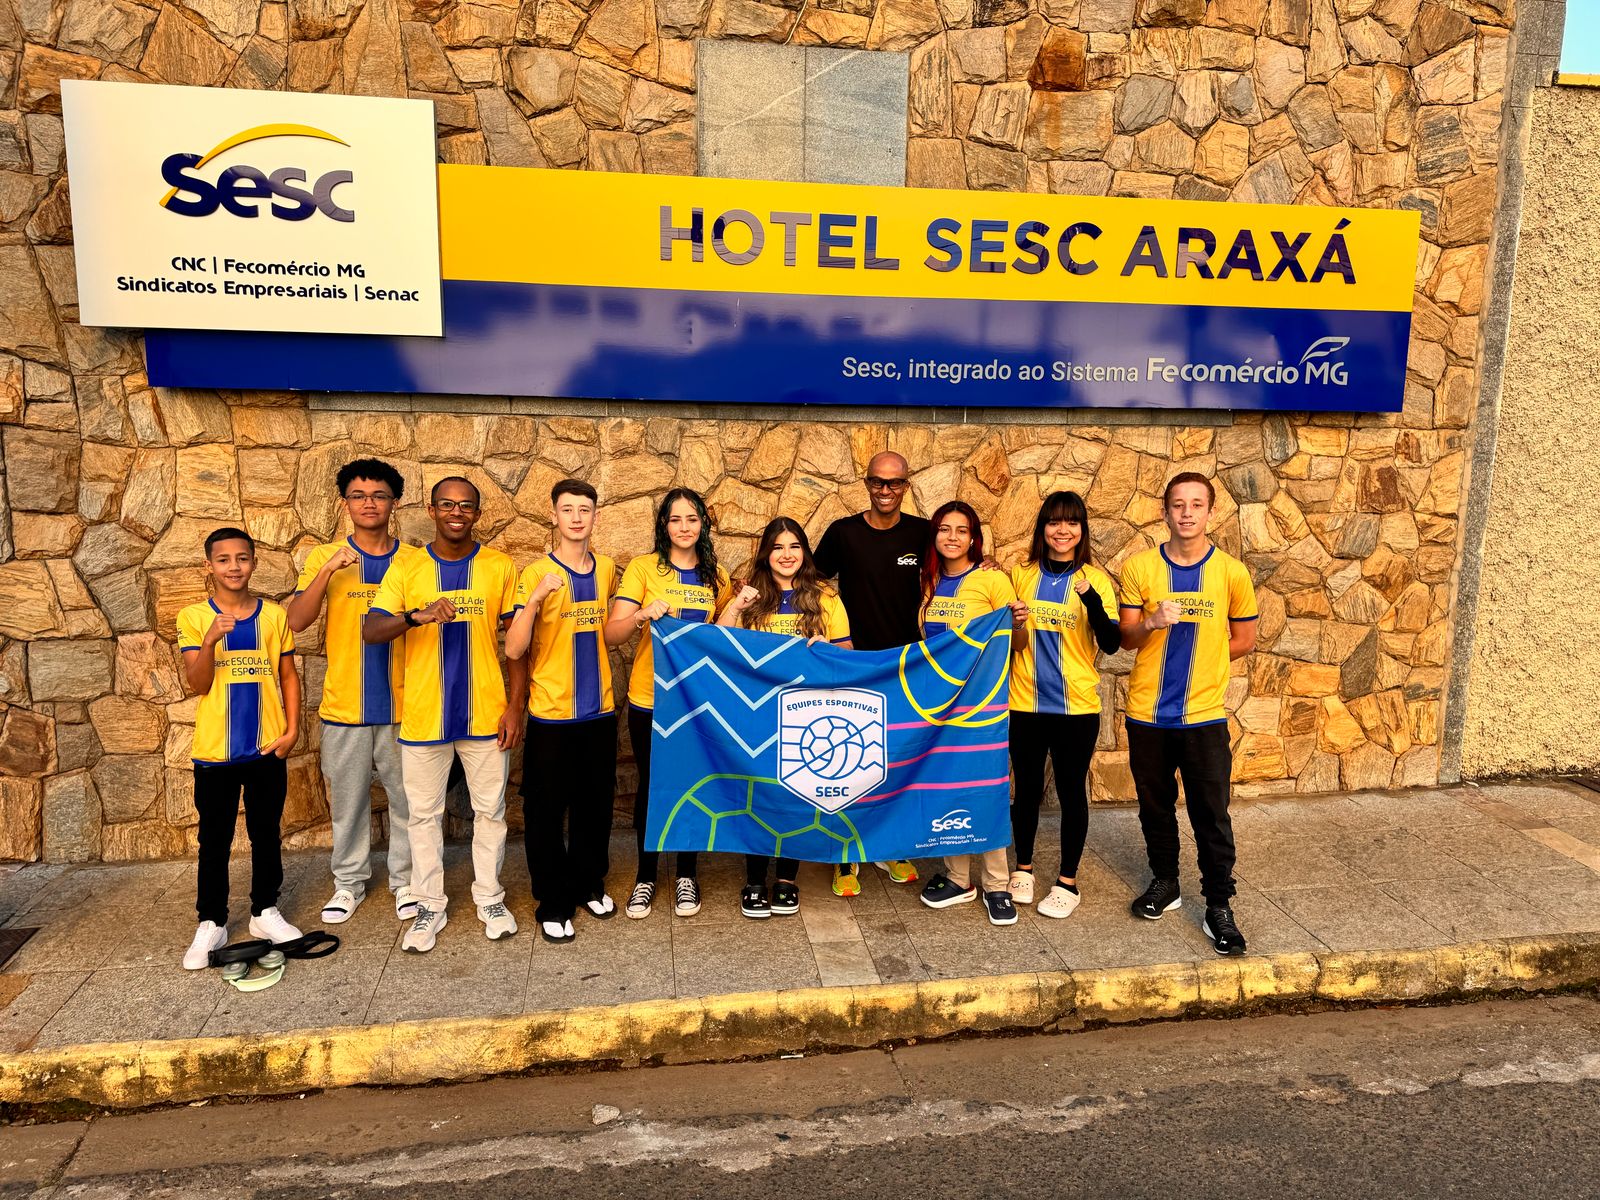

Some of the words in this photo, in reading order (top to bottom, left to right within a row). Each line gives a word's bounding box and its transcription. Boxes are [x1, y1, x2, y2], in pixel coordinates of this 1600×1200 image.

[659, 205, 901, 271] HOTEL
[923, 217, 1104, 277] SESC
[1119, 217, 1357, 286] ARAXÁ
[171, 256, 207, 272] CNC
[223, 258, 331, 277] Fecomércio
[337, 263, 366, 279] MG
[116, 276, 217, 295] Sindicatos
[223, 280, 348, 299] Empresariais
[364, 285, 420, 302] Senac
[842, 357, 901, 380] Sesc,
[908, 359, 1012, 384] integrado
[1018, 365, 1045, 381] ao
[1051, 361, 1139, 382] Sistema
[1146, 357, 1299, 385] Fecomércio
[1305, 361, 1350, 386] MG
[447, 596, 474, 605] SCOLA
[455, 607, 484, 615] ORTES
[1180, 607, 1214, 618] SPORTES
[230, 656, 263, 666] ESCOLA
[786, 699, 823, 712] EQUIPES
[825, 699, 879, 715] ESPORTIVAS
[815, 786, 849, 798] SESC
